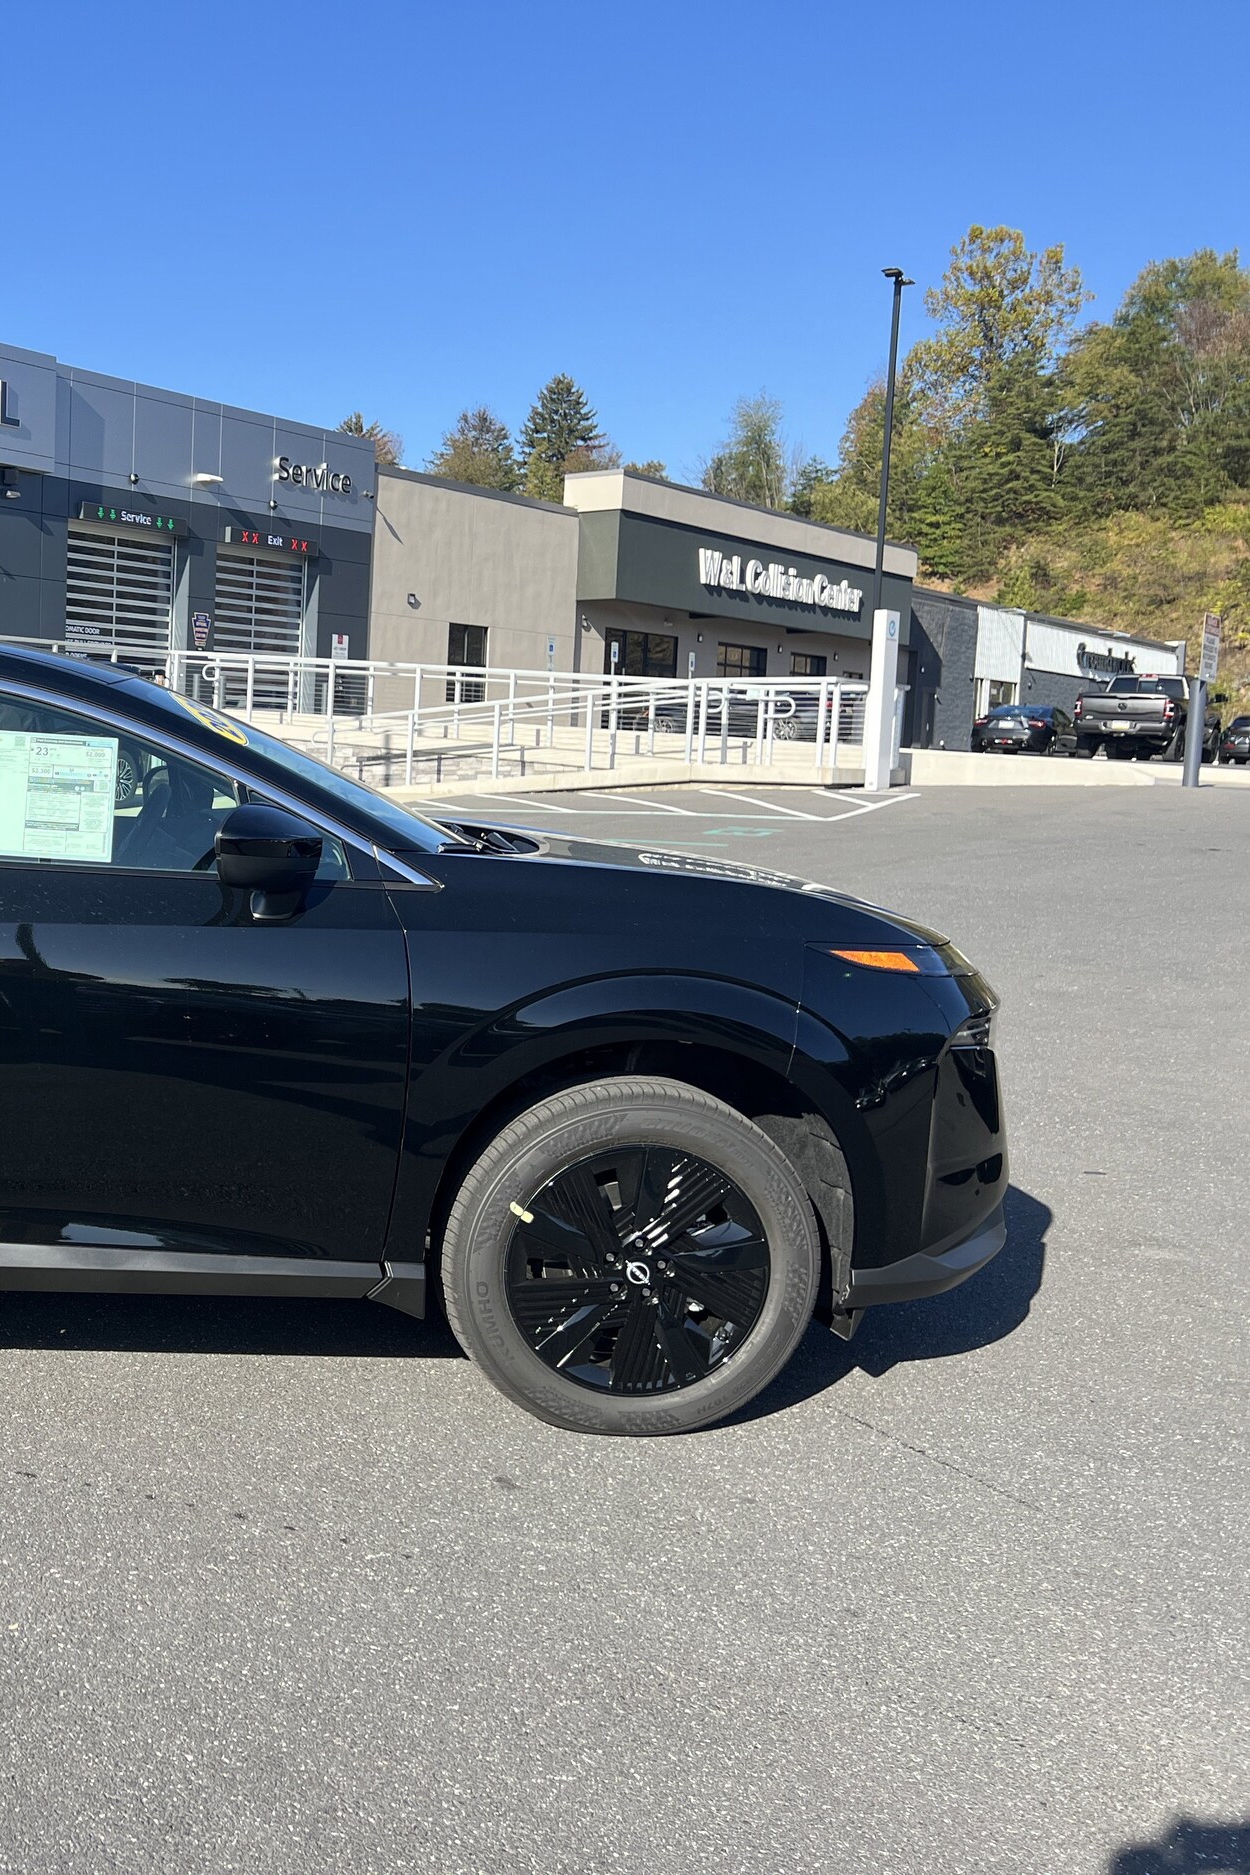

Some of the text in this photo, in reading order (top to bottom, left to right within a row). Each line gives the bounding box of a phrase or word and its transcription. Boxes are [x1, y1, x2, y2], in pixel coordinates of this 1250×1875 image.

[273, 456, 352, 494] Service
[120, 510, 152, 525] Service
[267, 535, 283, 547] Exit
[699, 547, 863, 613] W&L Collision Center
[84, 627, 100, 635] DOOR
[35, 746, 49, 756] 23
